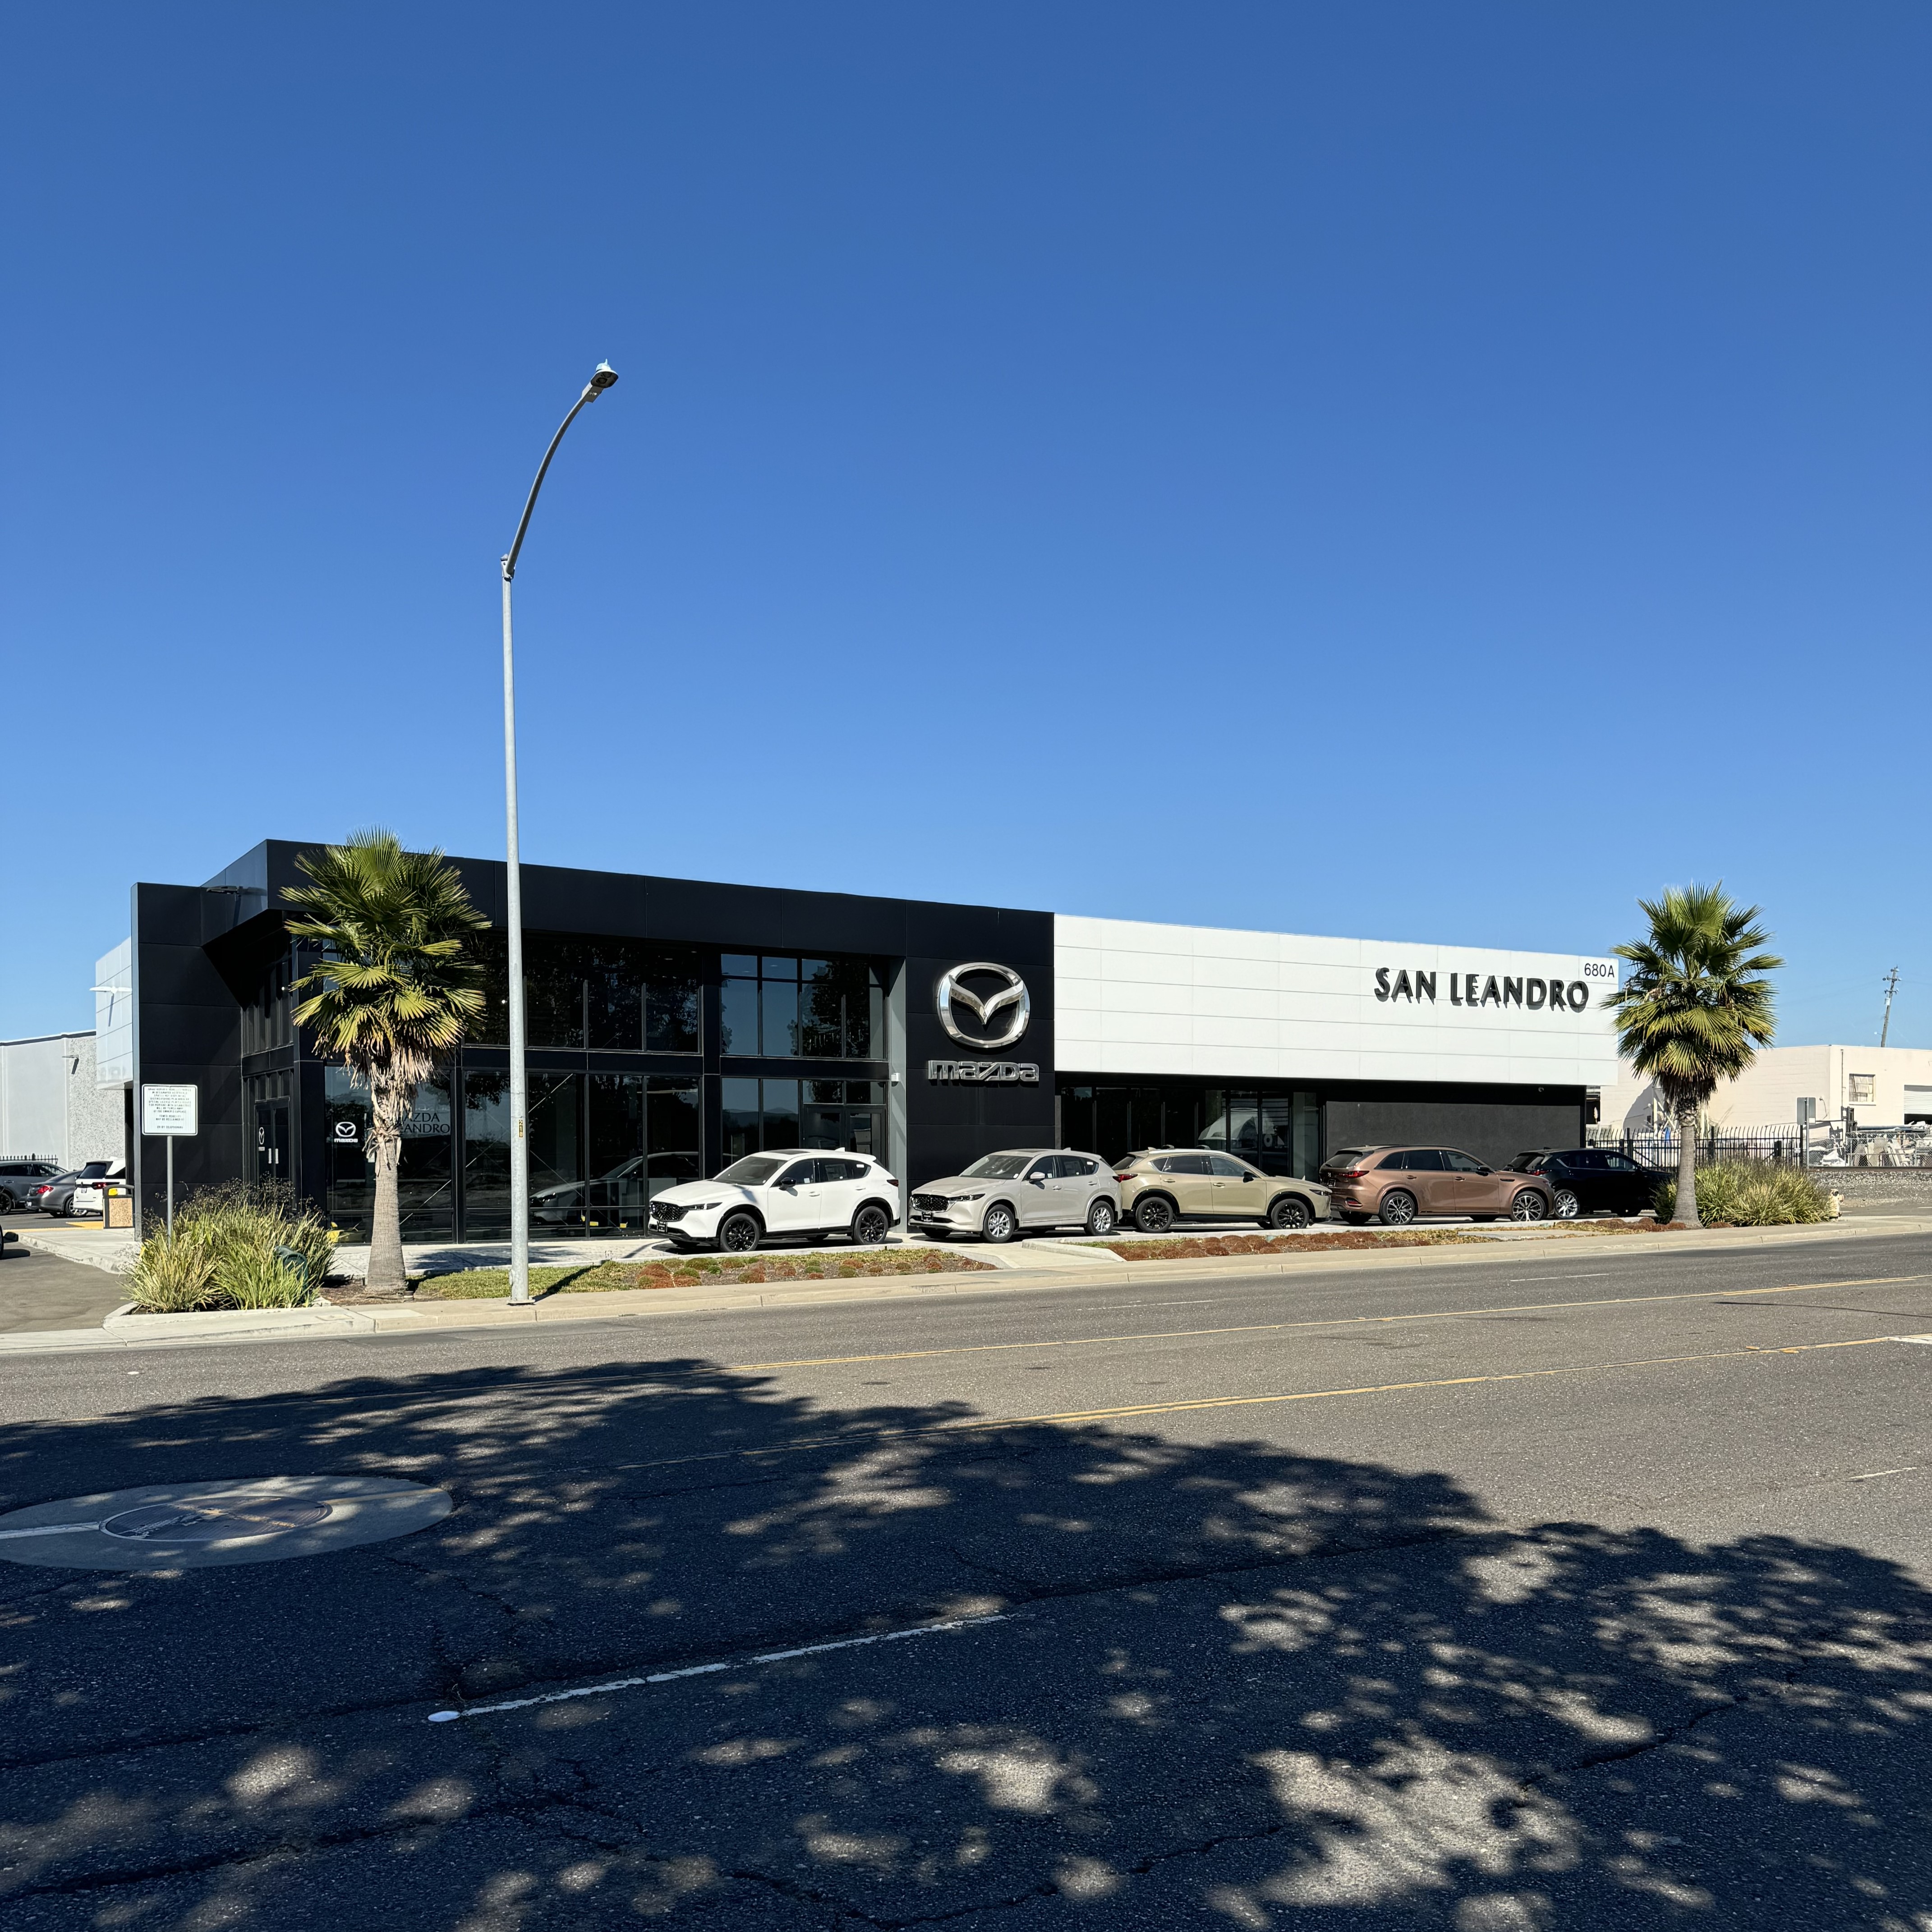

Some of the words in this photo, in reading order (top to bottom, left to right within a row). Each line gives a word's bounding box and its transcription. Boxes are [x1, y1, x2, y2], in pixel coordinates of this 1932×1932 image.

[1584, 963, 1615, 978] 680A
[1374, 967, 1436, 1000] SAN
[1450, 973, 1589, 1008] LEANDRO
[402, 1112, 440, 1122] AZDA
[400, 1123, 450, 1133] ANDRO
